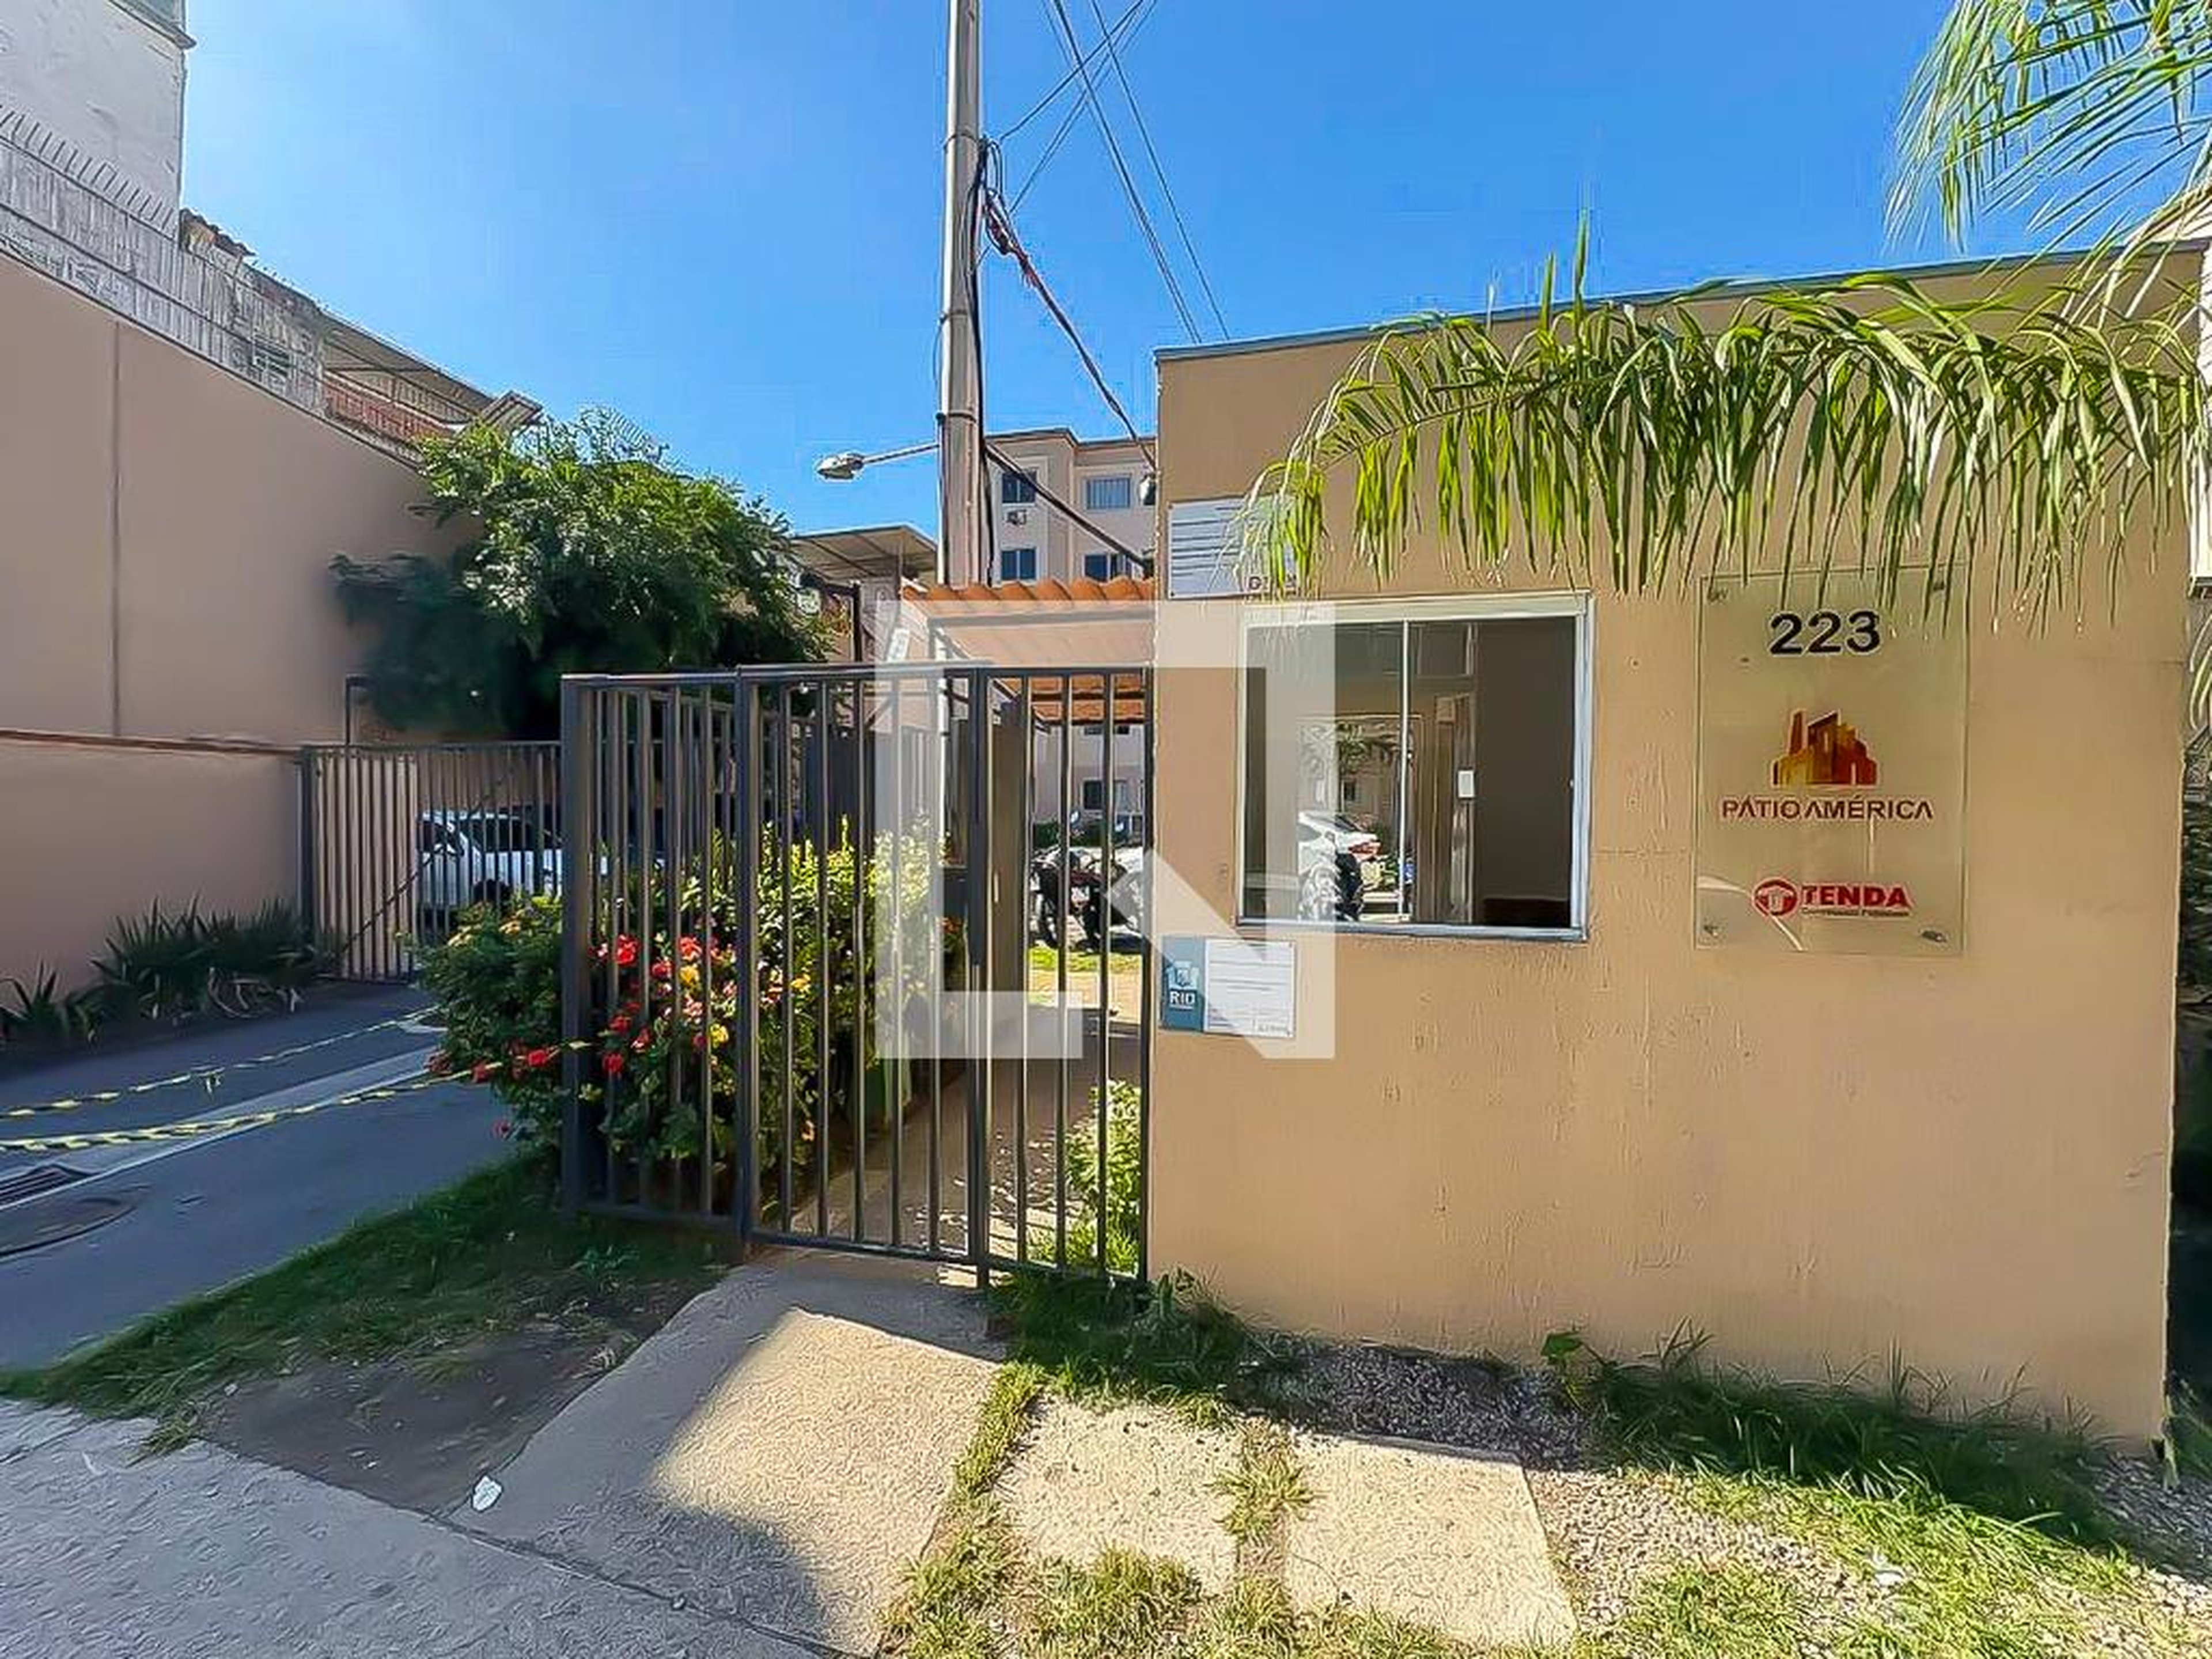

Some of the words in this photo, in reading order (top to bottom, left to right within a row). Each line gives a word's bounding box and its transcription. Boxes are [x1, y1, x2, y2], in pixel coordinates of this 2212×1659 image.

[1769, 610, 1881, 655] 223
[1801, 885, 1911, 908] TENDA
[1169, 990, 1196, 1005] RIO
